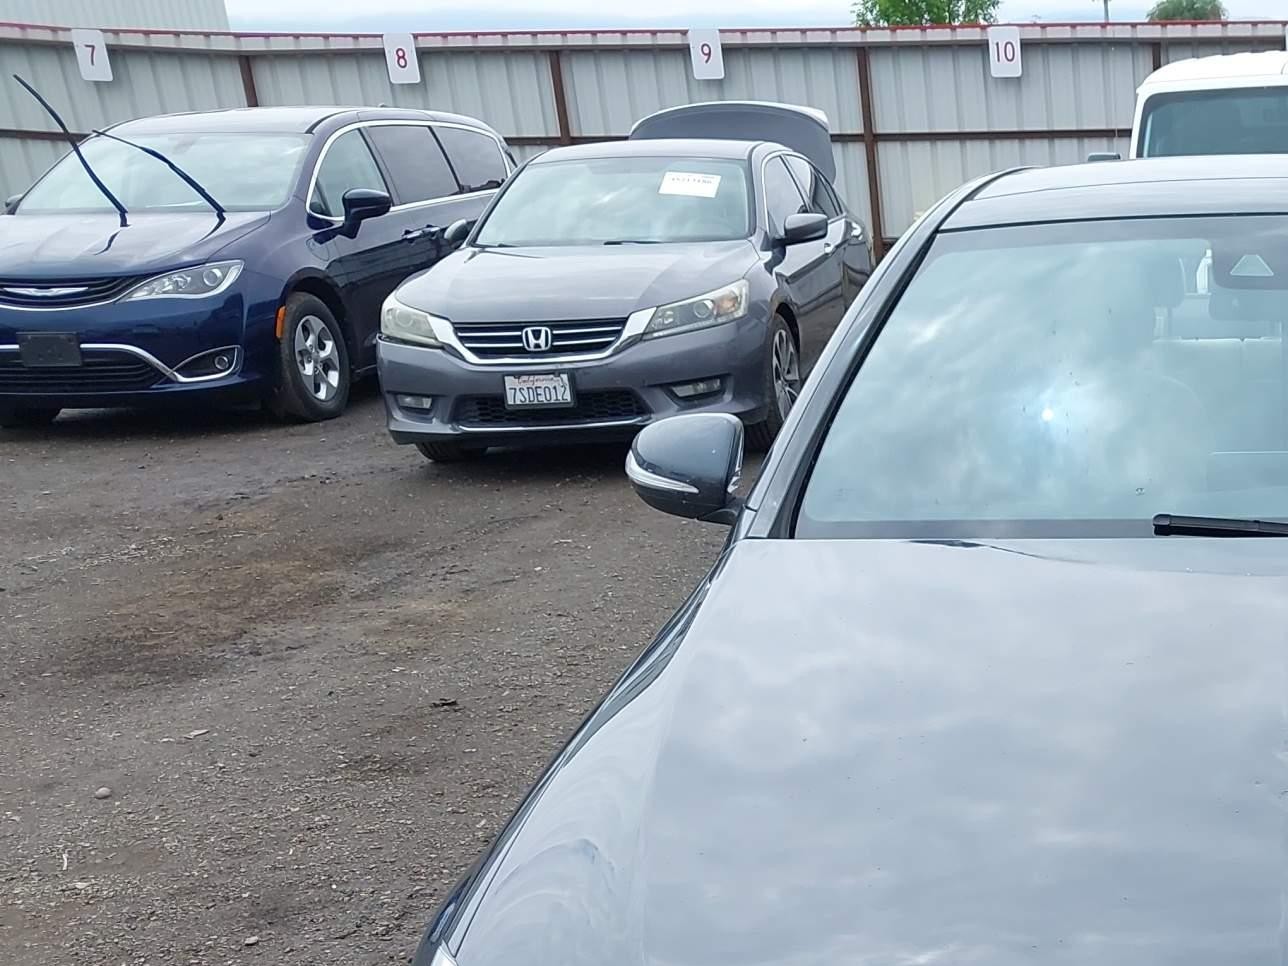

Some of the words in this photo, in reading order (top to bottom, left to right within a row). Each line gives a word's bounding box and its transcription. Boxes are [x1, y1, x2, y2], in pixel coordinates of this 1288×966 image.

[84, 44, 95, 66] 7
[396, 48, 408, 69] 8
[701, 43, 712, 64] 9
[996, 41, 1015, 63] 10
[508, 385, 569, 404] 7SDE012
